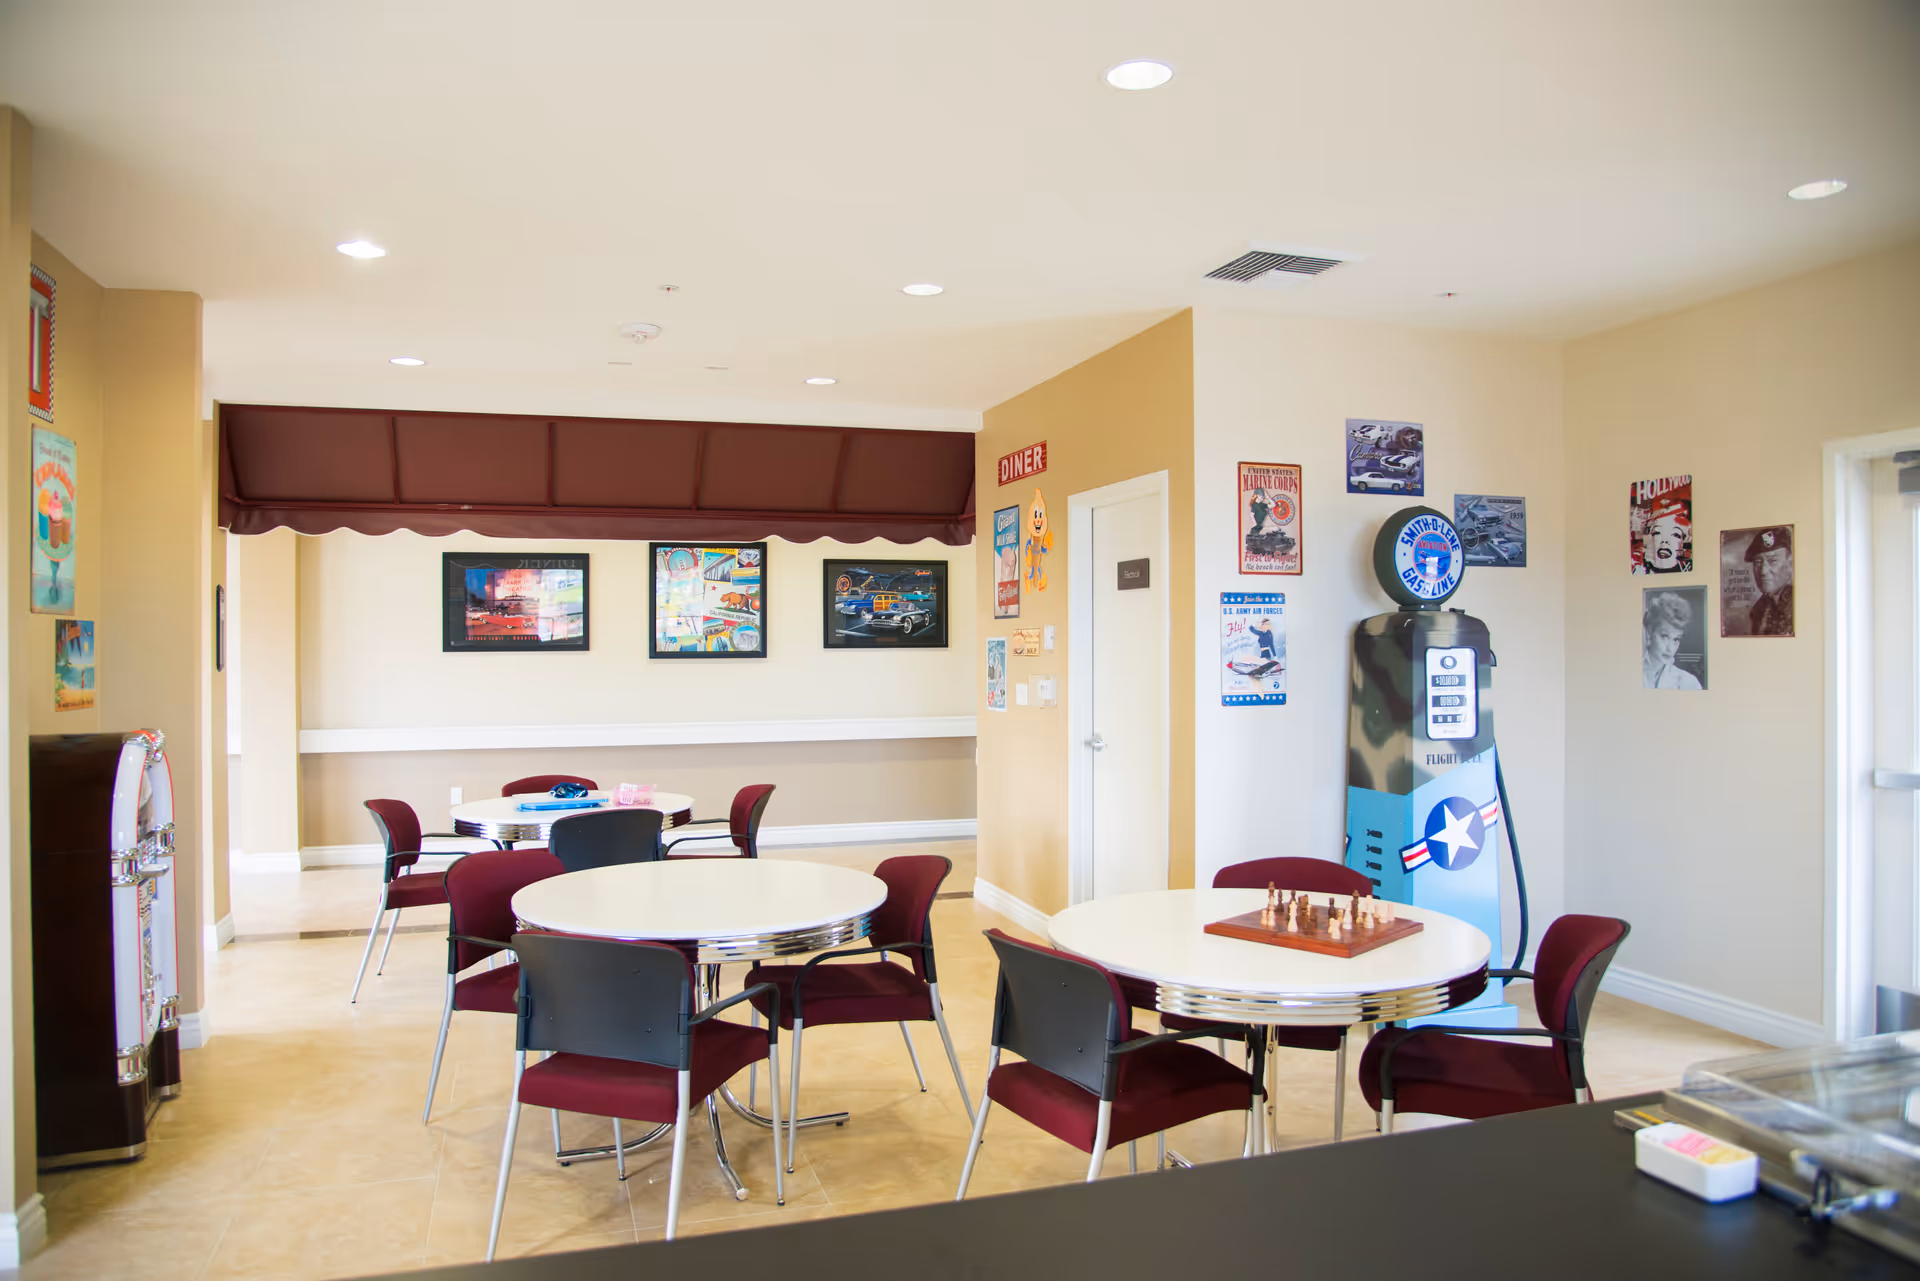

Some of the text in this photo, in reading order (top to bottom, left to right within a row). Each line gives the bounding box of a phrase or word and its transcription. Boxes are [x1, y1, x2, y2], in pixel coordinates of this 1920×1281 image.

[1349, 443, 1383, 462] Camaro
[1001, 446, 1043, 482] DINER
[1248, 467, 1293, 476] UNITED STATES
[1243, 474, 1298, 494] MARINE CORPS
[997, 511, 1016, 534] Giant
[1510, 511, 1524, 520] 1959
[996, 533, 1006, 547] MILK
[1417, 540, 1448, 552] AVIATION
[1244, 551, 1298, 565] First to Fight!
[709, 609, 735, 619] CALIFORNIA
[1223, 607, 1283, 615] U.S. ARMY AIR FORCES
[1226, 617, 1247, 638] Fly!
[1426, 753, 1457, 766] FLIGHT
